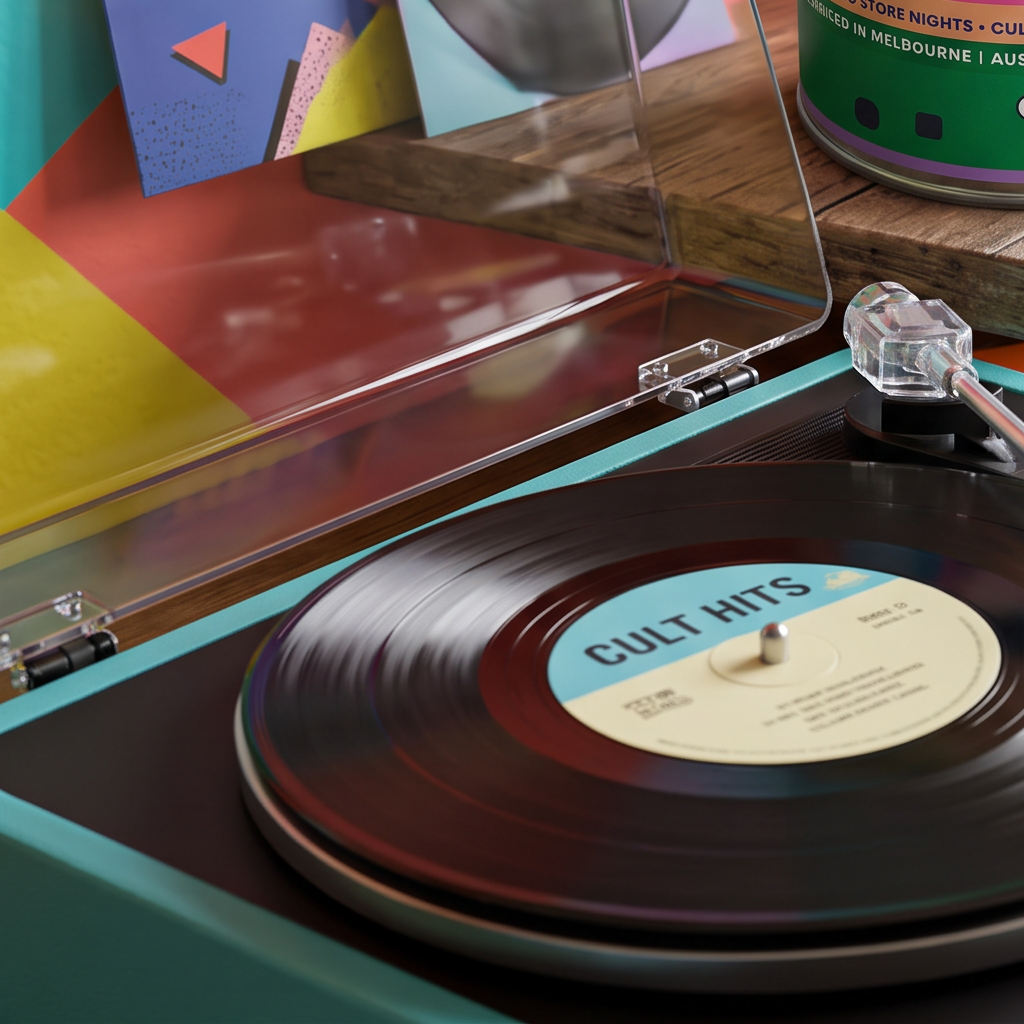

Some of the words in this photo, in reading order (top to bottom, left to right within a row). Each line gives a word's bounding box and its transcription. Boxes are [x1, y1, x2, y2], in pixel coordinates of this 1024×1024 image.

[909, 10, 973, 32] NIGHTS
[853, 22, 867, 38] IN
[871, 29, 972, 63] MELBOURNE
[584, 612, 703, 666] CULT
[699, 576, 812, 623] HITS
